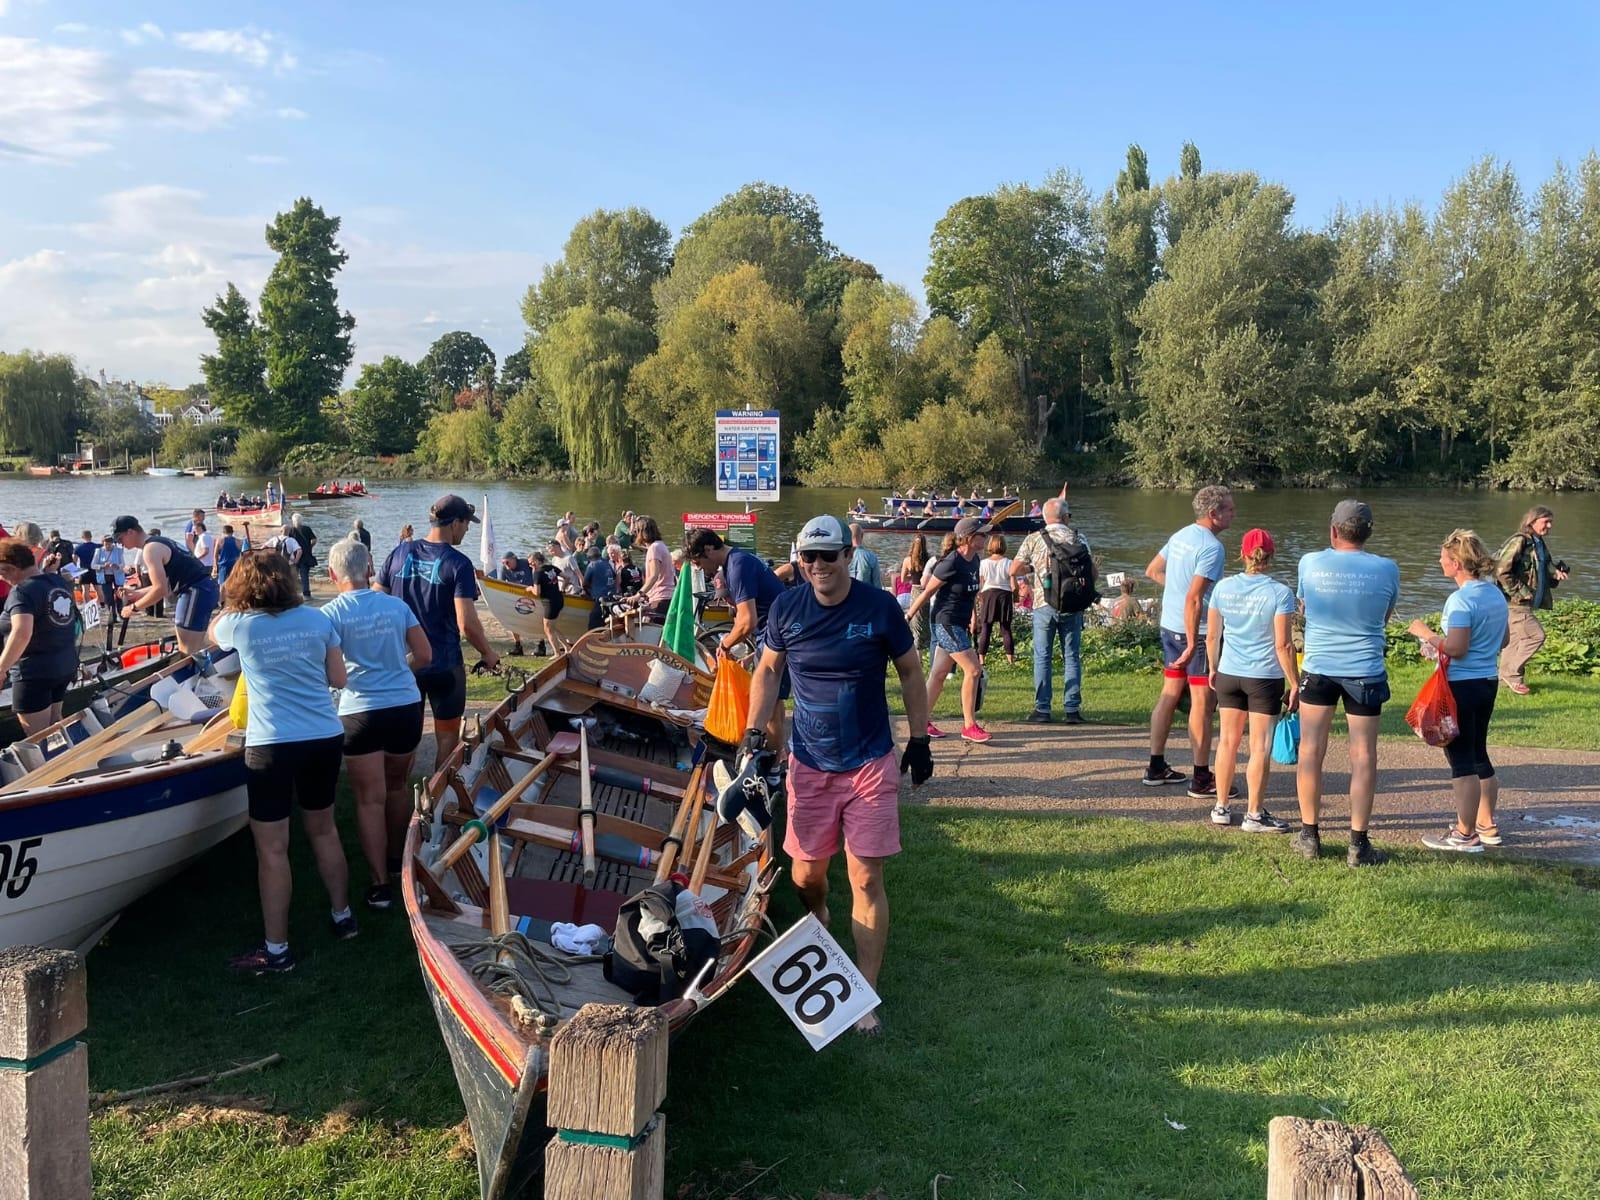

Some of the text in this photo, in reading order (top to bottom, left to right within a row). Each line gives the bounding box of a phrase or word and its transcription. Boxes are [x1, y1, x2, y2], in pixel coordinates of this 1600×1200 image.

[1111, 576, 1121, 585] 74
[86, 604, 98, 625] 102
[275, 631, 297, 641] RIVER
[299, 630, 321, 638] RACE
[812, 927, 864, 992] The Great River Race
[772, 944, 852, 1025] 66
